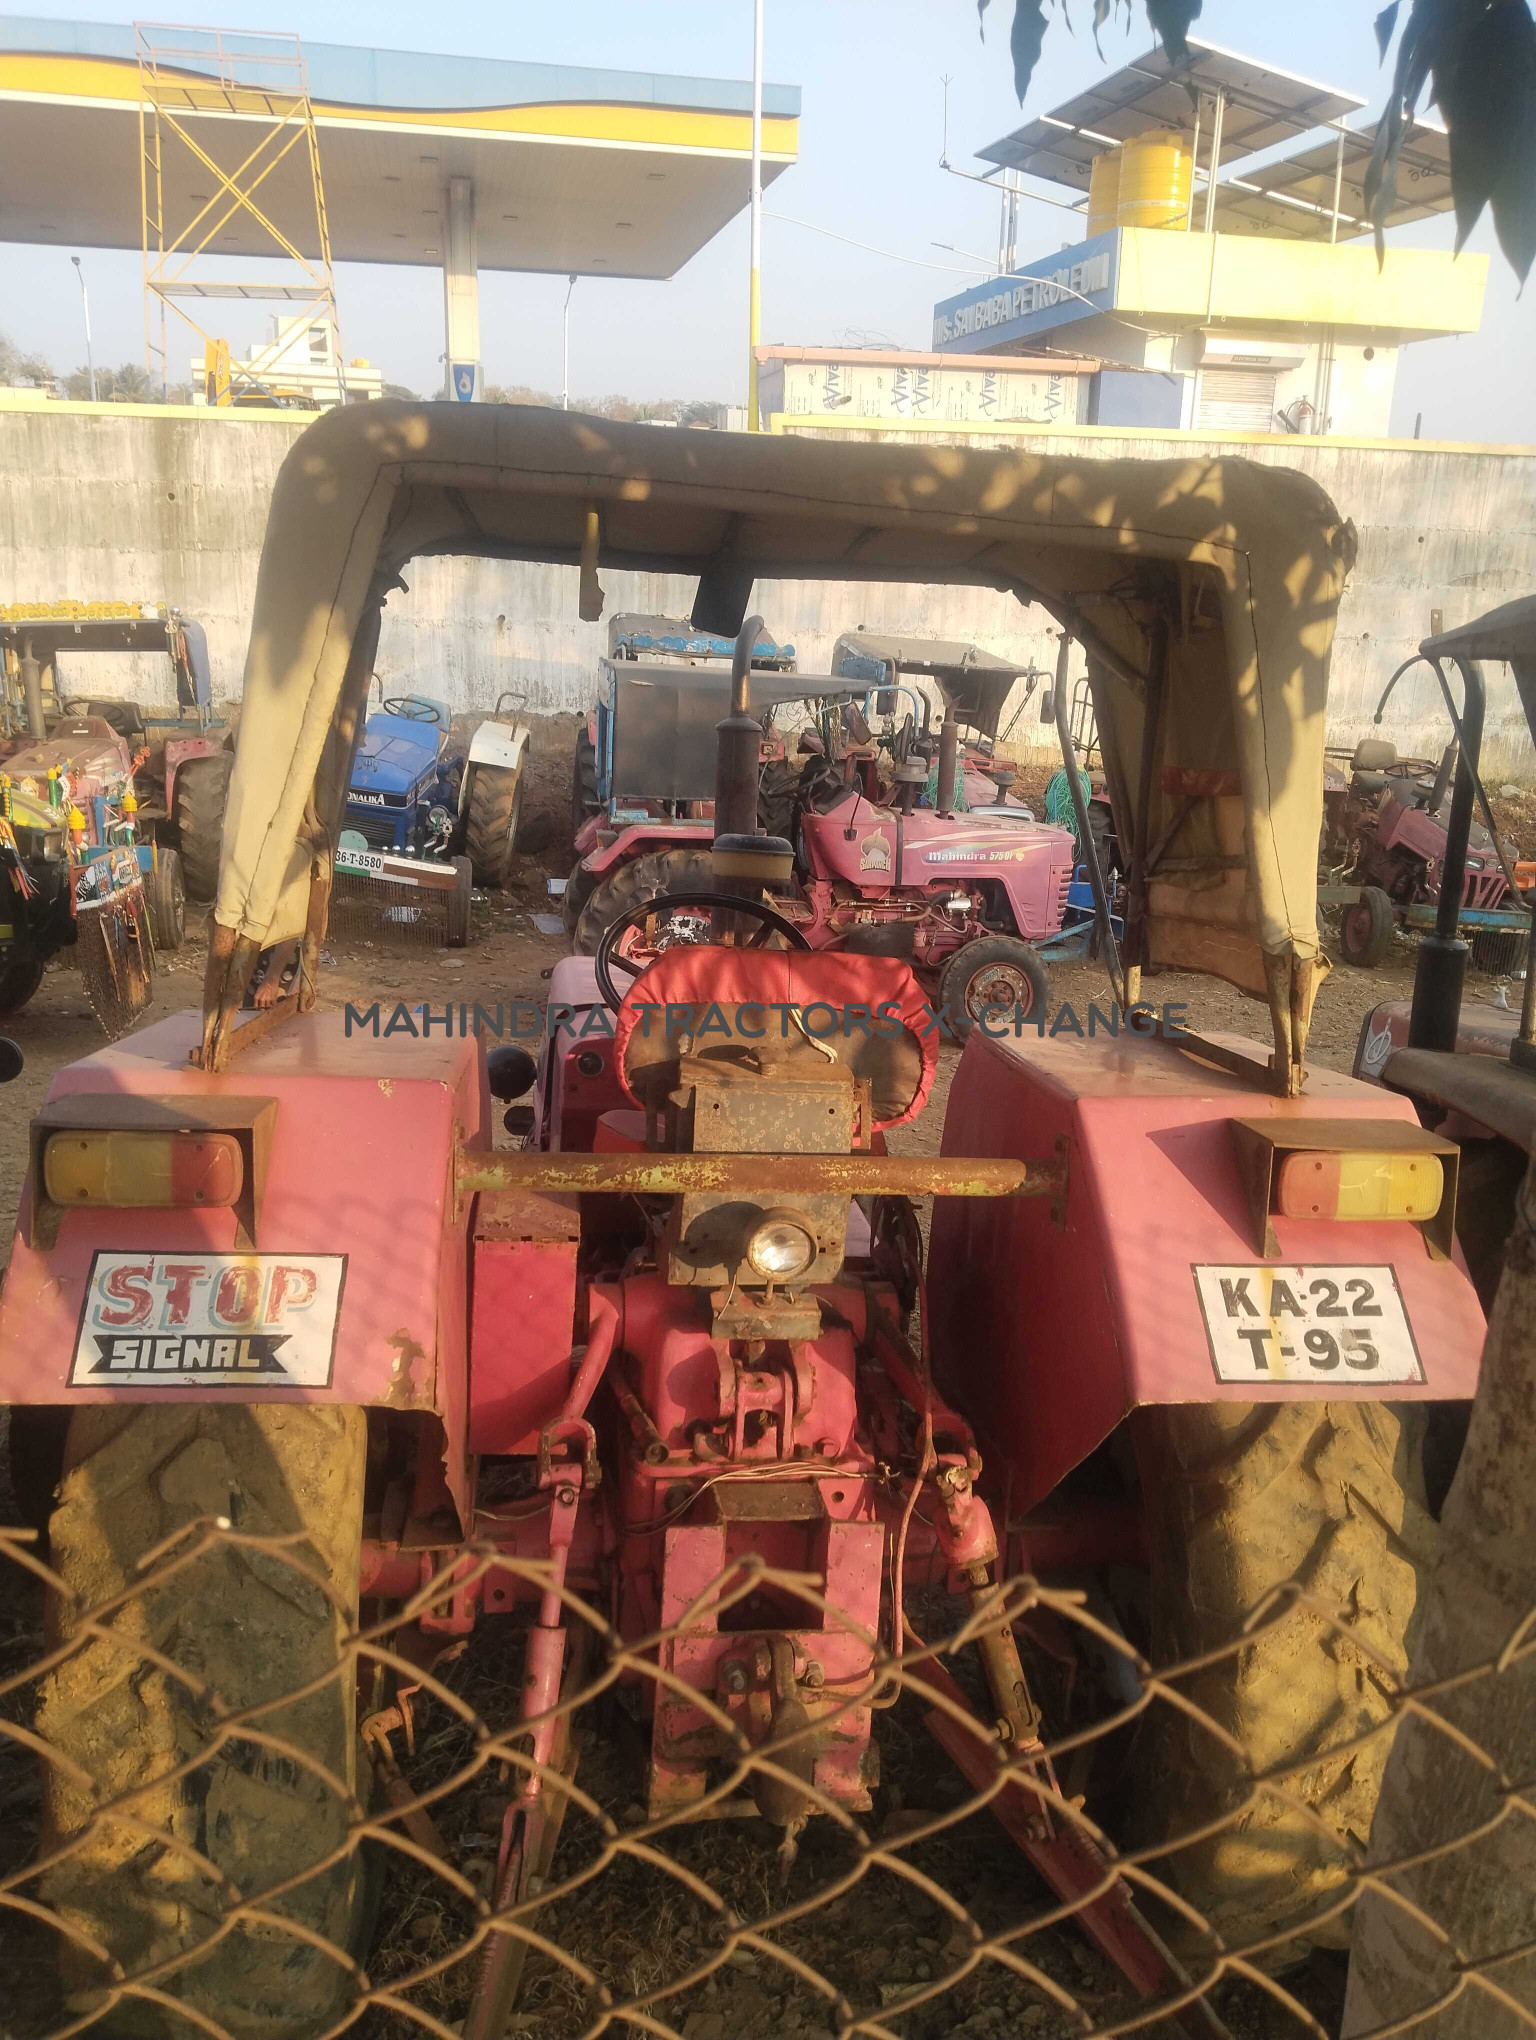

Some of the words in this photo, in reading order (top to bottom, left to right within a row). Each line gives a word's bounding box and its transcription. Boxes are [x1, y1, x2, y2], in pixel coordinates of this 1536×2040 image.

[954, 304, 976, 338] SAI
[975, 291, 1012, 331] BABA
[1012, 252, 1110, 318] PETROLEUM
[347, 791, 385, 806] ONALIKA
[928, 851, 986, 861] Mahindra
[92, 1264, 317, 1331] STOP
[110, 1339, 260, 1370] SIGNAL
[1237, 1328, 1380, 1370] T-95
